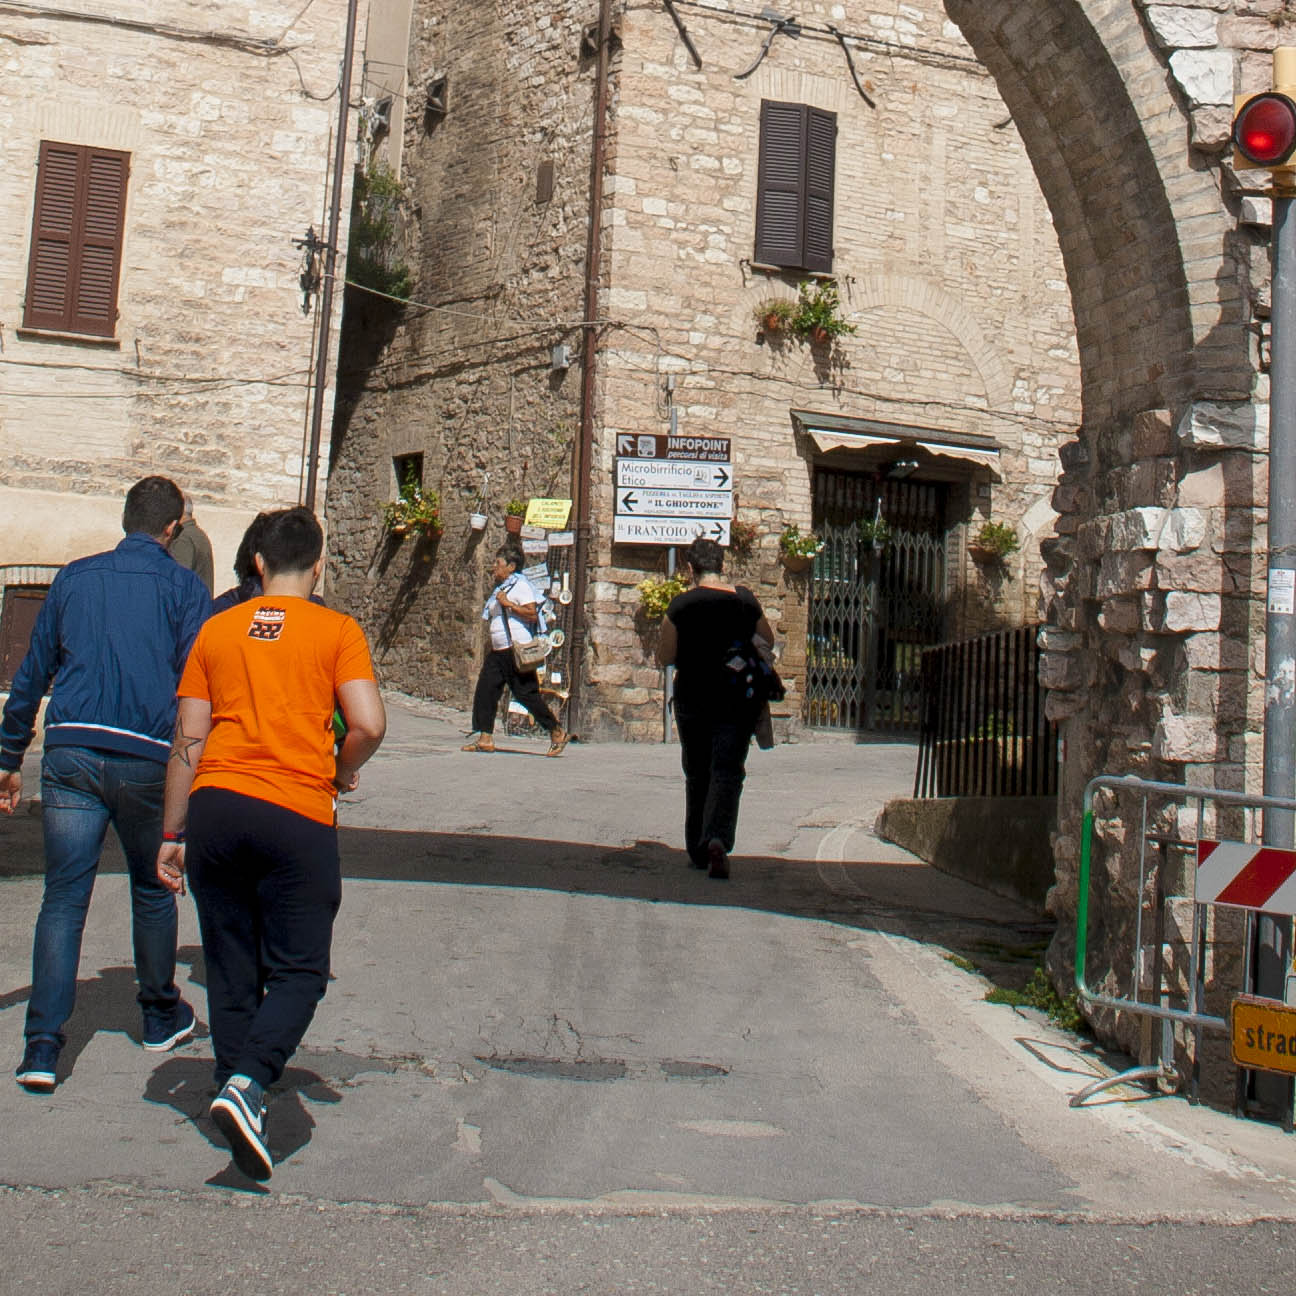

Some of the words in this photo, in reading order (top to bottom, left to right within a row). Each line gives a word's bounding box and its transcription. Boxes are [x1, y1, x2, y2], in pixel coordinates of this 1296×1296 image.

[667, 437, 729, 451] INFOPOINT
[699, 451, 708, 459] di
[708, 451, 728, 460] visita
[621, 462, 693, 476] Microbirrificio
[622, 475, 646, 486] Etico
[627, 524, 688, 537] FRANTOIO
[248, 621, 283, 639] 222
